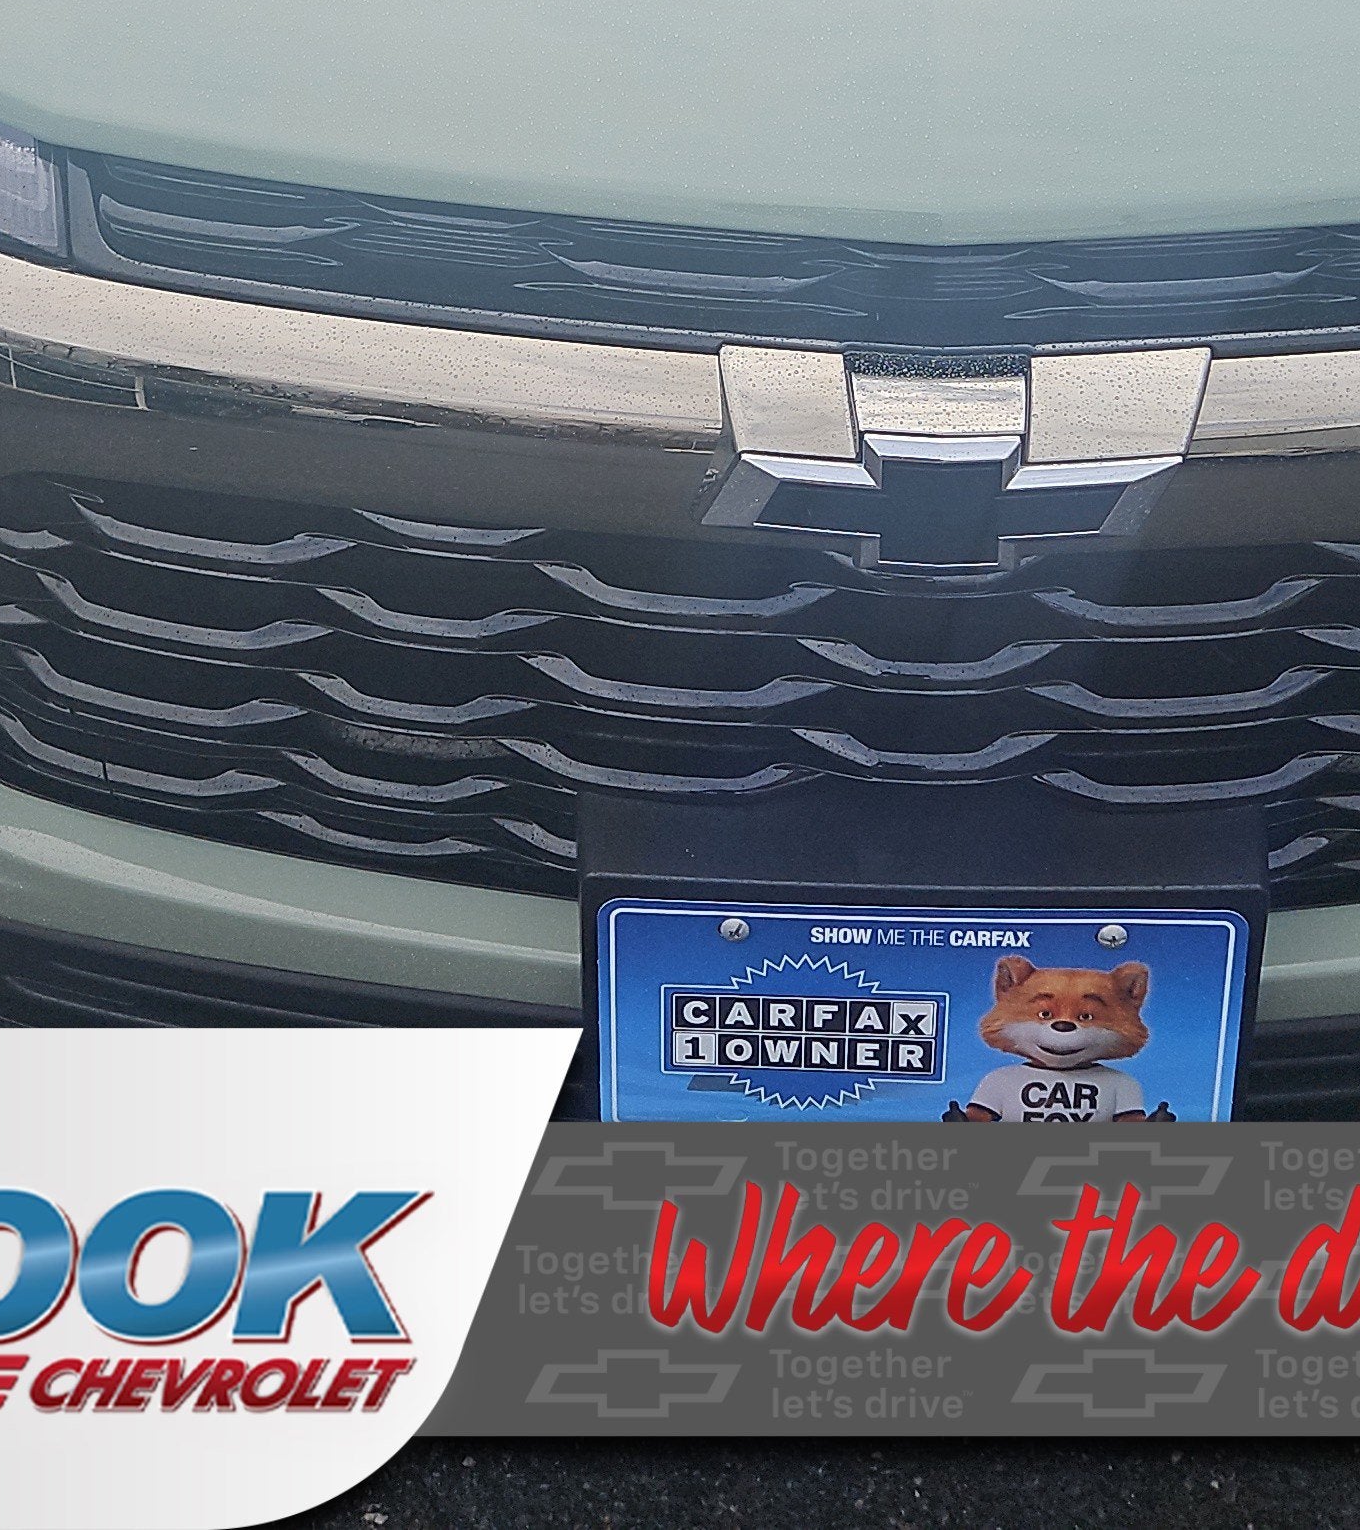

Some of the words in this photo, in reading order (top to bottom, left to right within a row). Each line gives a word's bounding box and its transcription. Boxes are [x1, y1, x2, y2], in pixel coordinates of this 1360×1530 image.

[810, 927, 872, 945] SHOW
[877, 929, 906, 945] ME
[909, 929, 944, 946] THE
[949, 930, 1031, 948] CARFAX
[682, 999, 928, 1036] CARFAX
[1020, 1081, 1100, 1110] CAR
